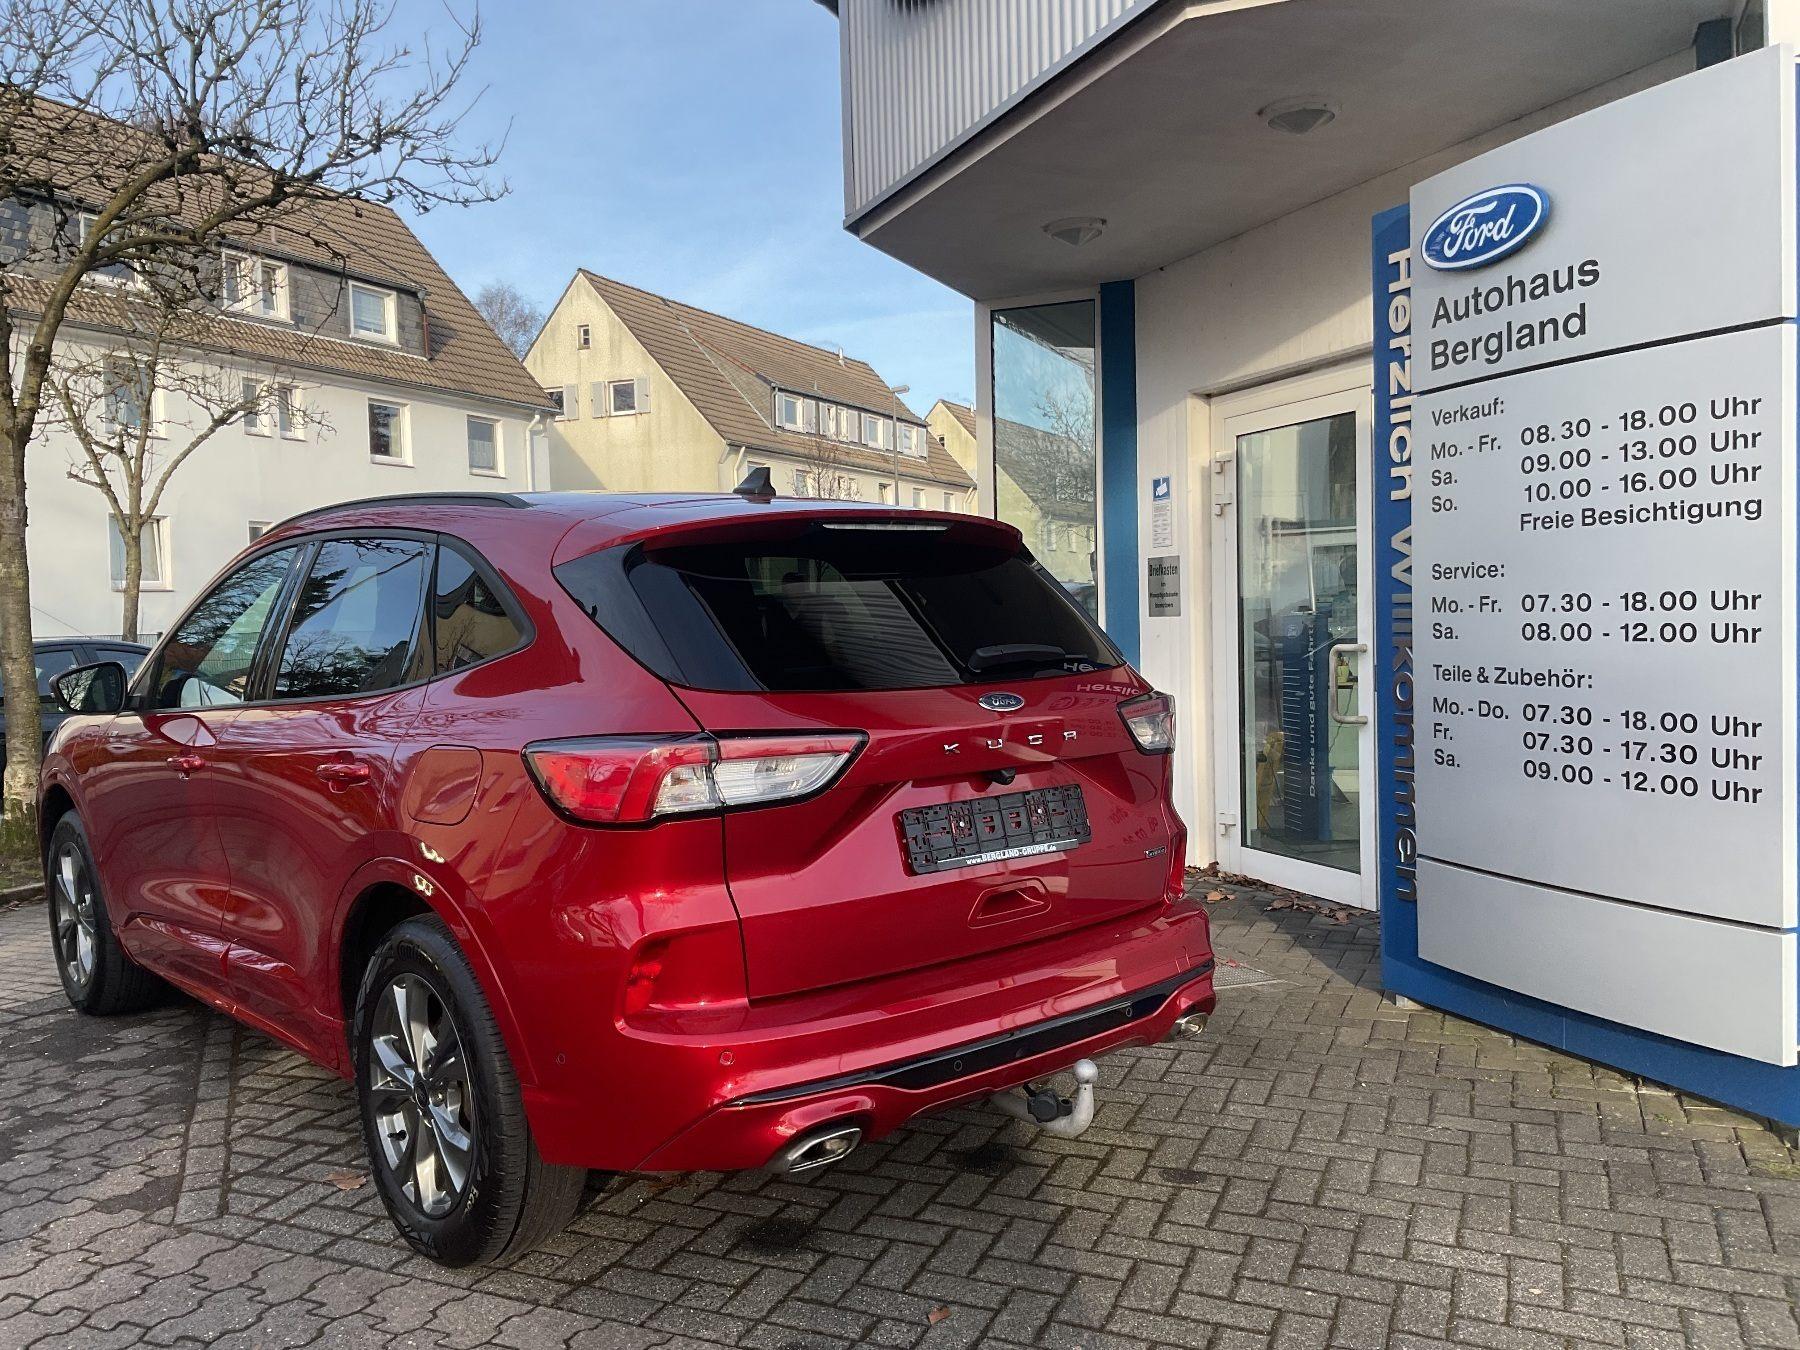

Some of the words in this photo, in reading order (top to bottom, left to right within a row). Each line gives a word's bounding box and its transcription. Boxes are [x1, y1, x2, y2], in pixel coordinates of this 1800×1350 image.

[1444, 201, 1517, 258] Ford
[1431, 259, 1600, 329] Autohaus
[1430, 303, 1587, 372] Bergland
[1389, 248, 1412, 501] Herzlich
[1431, 396, 1505, 427] Verkauf:
[1520, 417, 1591, 446] 08.30
[1618, 402, 1697, 432] 18.00
[1710, 396, 1762, 420] Uhr
[1431, 469, 1458, 487] Sa.
[1520, 447, 1592, 475] 09.00
[1618, 434, 1697, 463] 13.00
[1710, 429, 1762, 453] Uhr
[1431, 495, 1458, 513] So.
[1523, 477, 1592, 503] 10.00
[1618, 466, 1697, 494] 16.00
[1710, 462, 1762, 486] Uhr
[1520, 510, 1575, 532] Freie
[1581, 498, 1762, 527] Besichtigung
[1431, 561, 1505, 581] Service:
[1521, 592, 1592, 613] 07.30
[1619, 590, 1698, 612] 18.00
[1710, 589, 1762, 611] Uhr
[1432, 622, 1459, 640] Sa.
[1521, 622, 1593, 642] 08.00
[1619, 622, 1698, 643] 12.00
[1710, 622, 1763, 644] Uhr
[1308, 674, 1318, 711] gute
[1432, 663, 1472, 683] Teile
[1476, 666, 1491, 684] &
[1493, 666, 1593, 689] Zubehör:
[1308, 713, 1316, 744] und
[1522, 703, 1593, 727] 07.30
[1620, 709, 1698, 734] 18.00
[1711, 714, 1763, 738] Uhr
[942, 729, 1078, 755] KUGA
[1433, 722, 1453, 741] Fr.
[1522, 731, 1593, 756] 07.30
[1620, 740, 1698, 765] 17.30
[1711, 746, 1763, 771] Uhr
[1433, 748, 1461, 769] Sa.
[1523, 759, 1594, 786] 09.00
[1620, 770, 1699, 798] 12.00
[1711, 779, 1763, 804] Uhr
